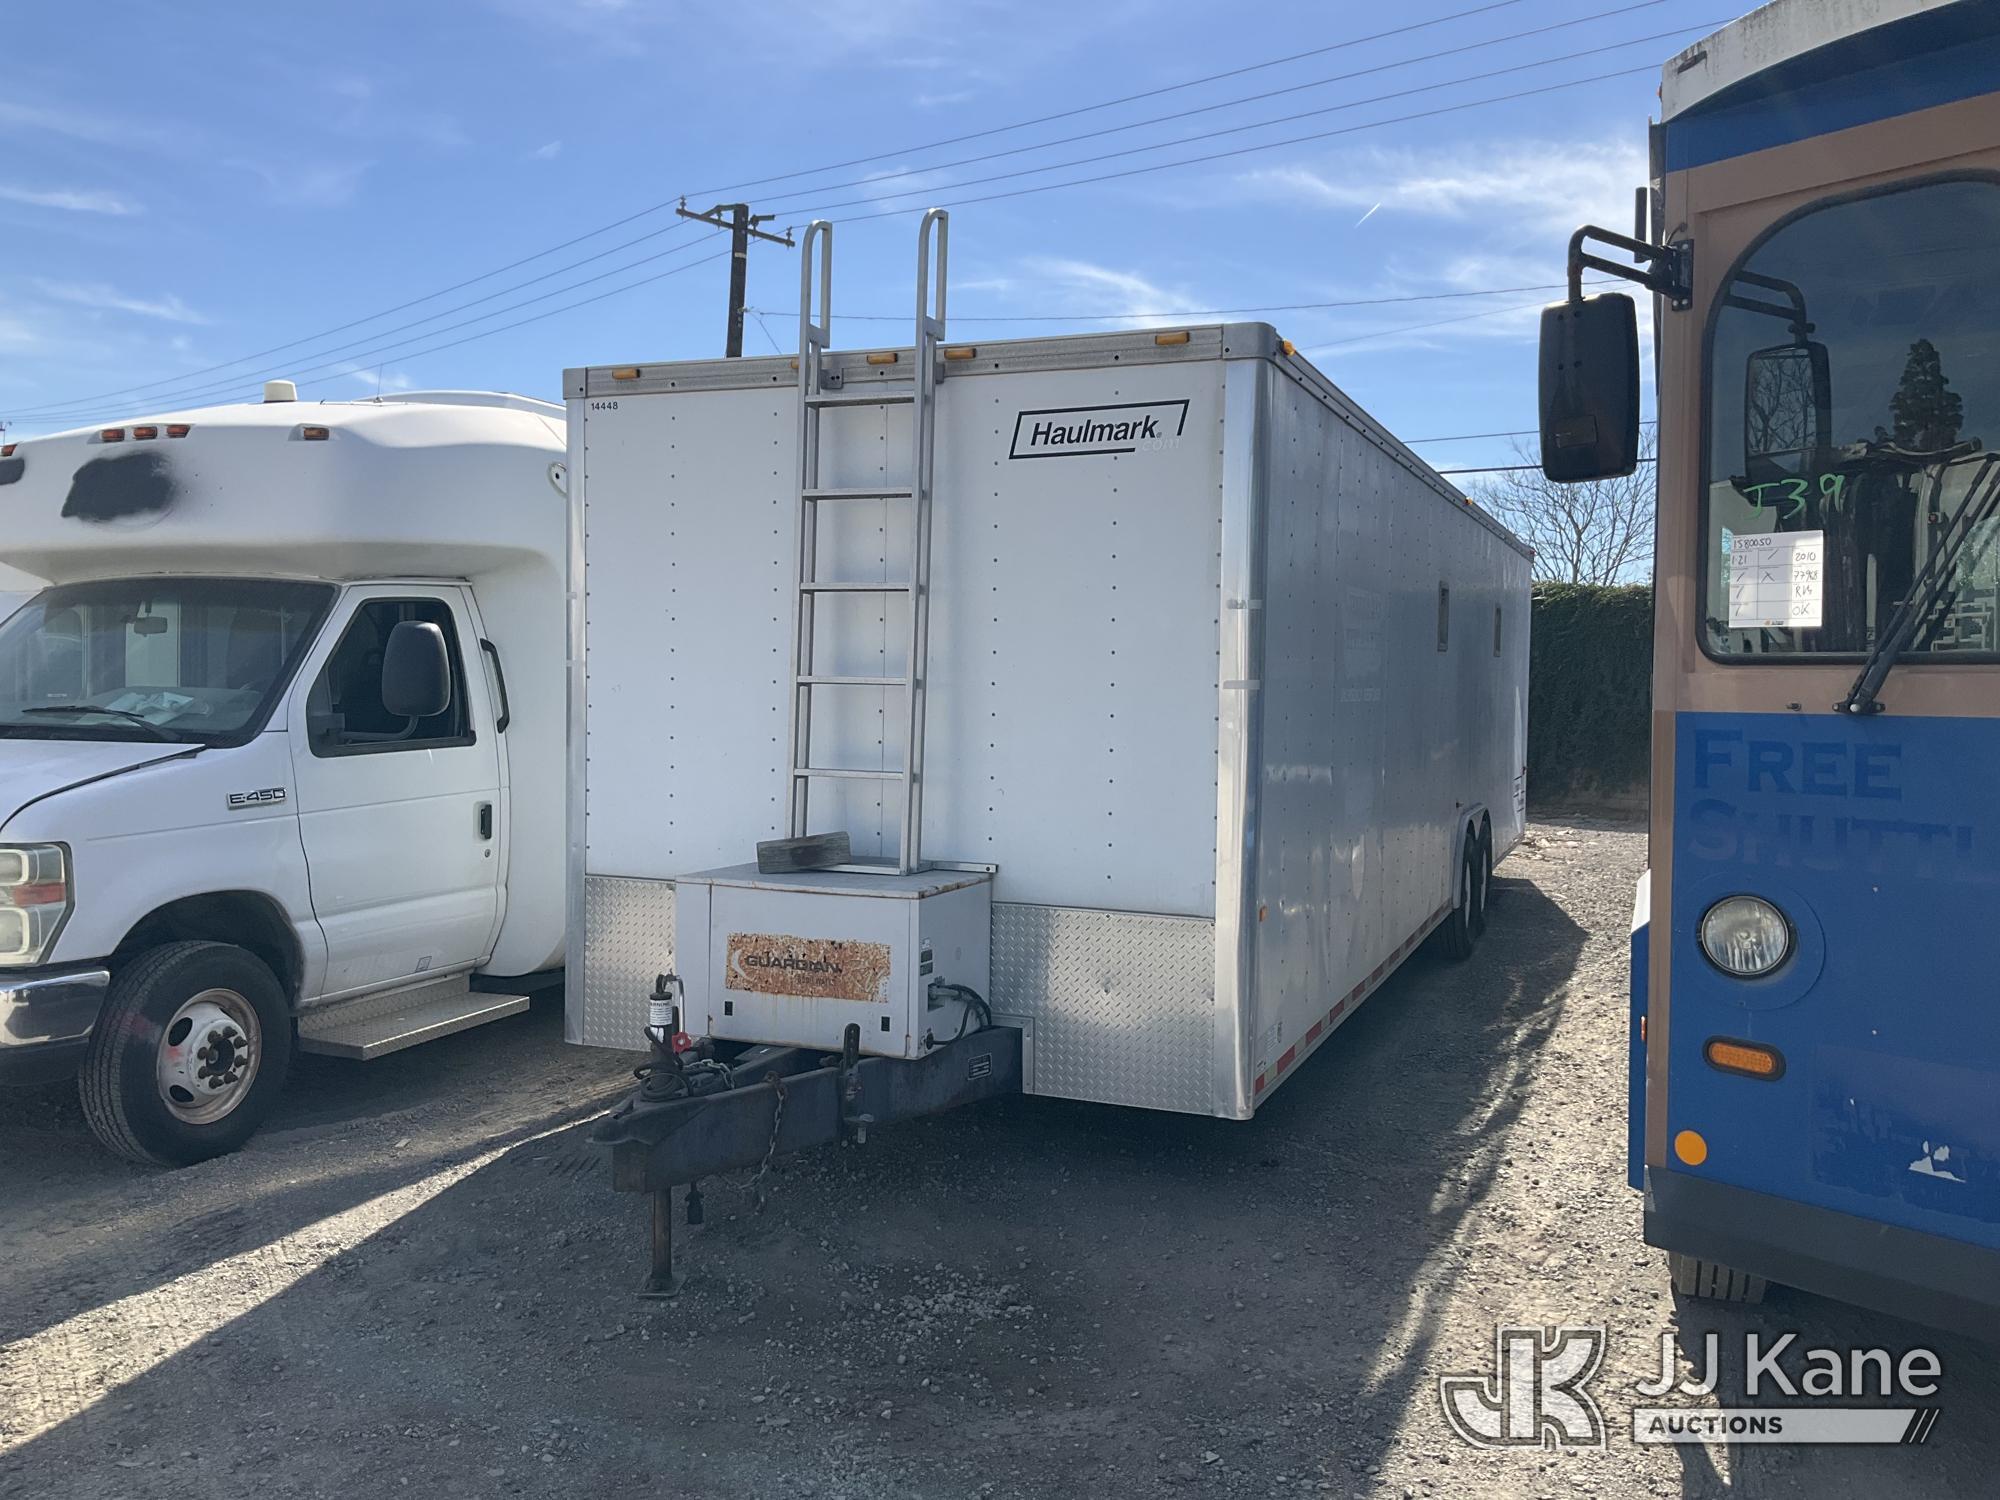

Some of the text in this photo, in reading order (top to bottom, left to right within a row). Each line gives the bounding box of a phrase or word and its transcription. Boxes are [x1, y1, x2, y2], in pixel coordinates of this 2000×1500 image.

[591, 402, 618, 410] 14448
[1030, 414, 1160, 447] Haulmark
[1794, 551, 1817, 562] 2010
[1692, 728, 1902, 801] FREE
[229, 788, 286, 804] E-450
[744, 954, 842, 974] GUARDIAN
